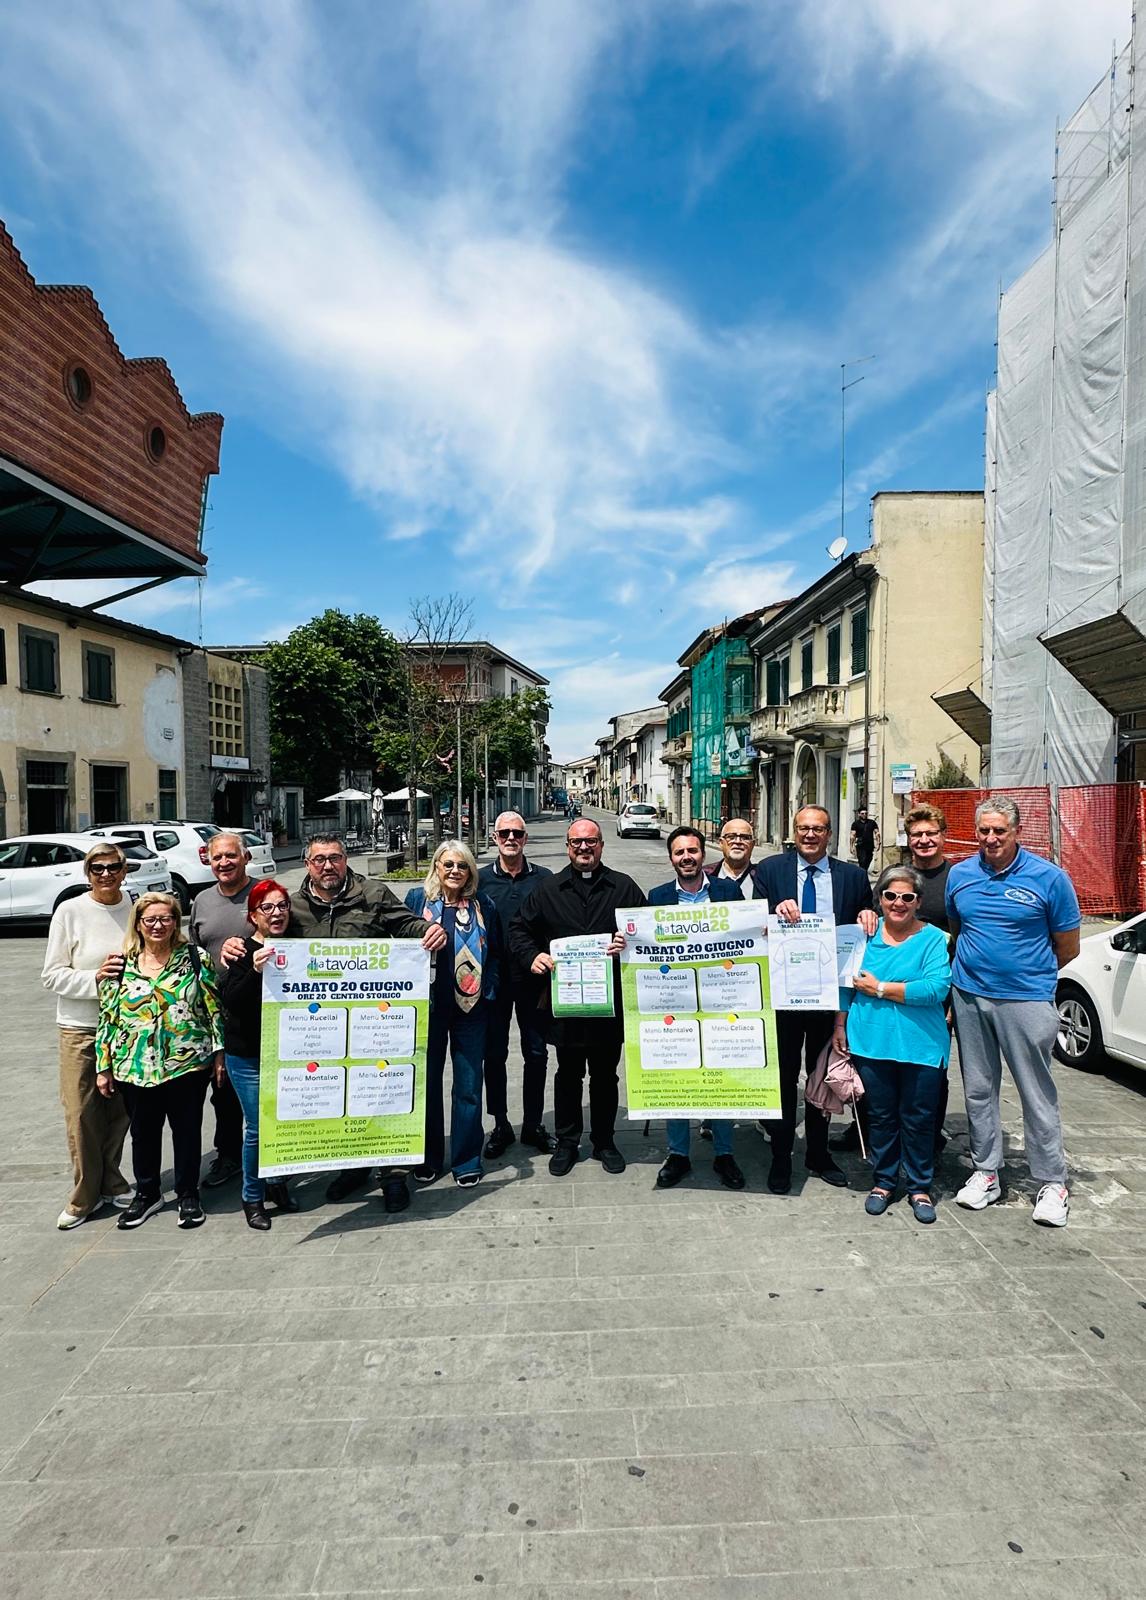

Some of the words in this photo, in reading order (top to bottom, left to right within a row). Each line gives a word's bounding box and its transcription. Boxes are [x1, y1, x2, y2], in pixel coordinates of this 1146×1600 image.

[635, 945, 684, 955] SABATO
[687, 944, 702, 953] 20
[704, 939, 754, 952] GIUGNO
[711, 950, 743, 958] STORICO
[282, 982, 338, 993] SABATO
[340, 982, 357, 991] 20
[360, 981, 413, 991] GIUGNO
